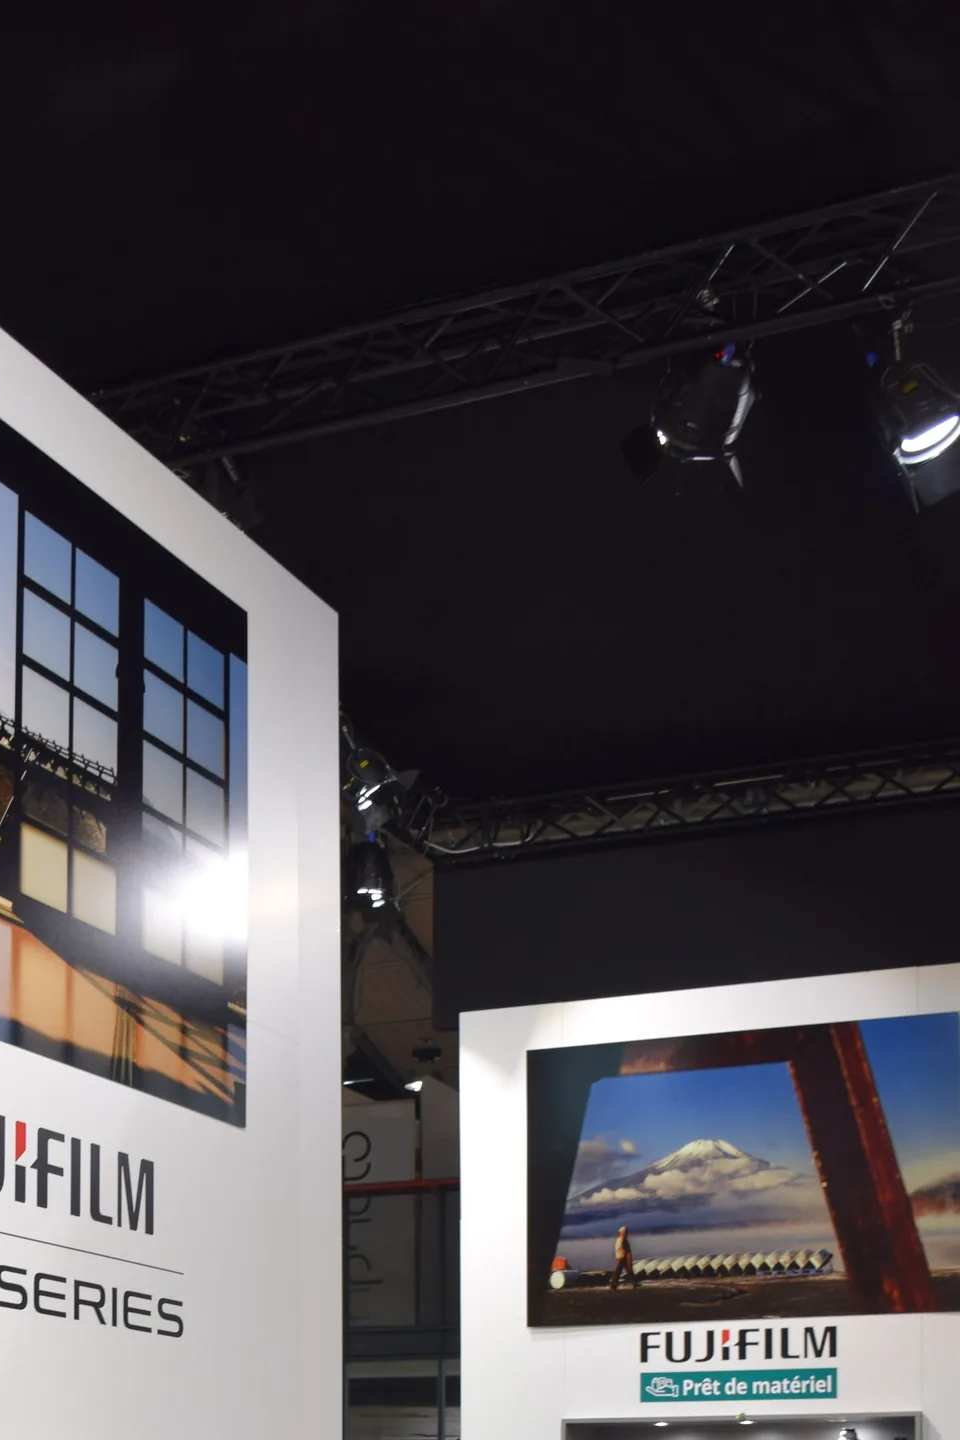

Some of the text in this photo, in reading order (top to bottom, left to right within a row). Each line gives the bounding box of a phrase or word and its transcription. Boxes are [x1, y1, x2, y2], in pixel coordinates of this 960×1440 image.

[640, 1325, 838, 1363] FUJIFILM
[682, 1374, 833, 1396] Prêt de matériel
